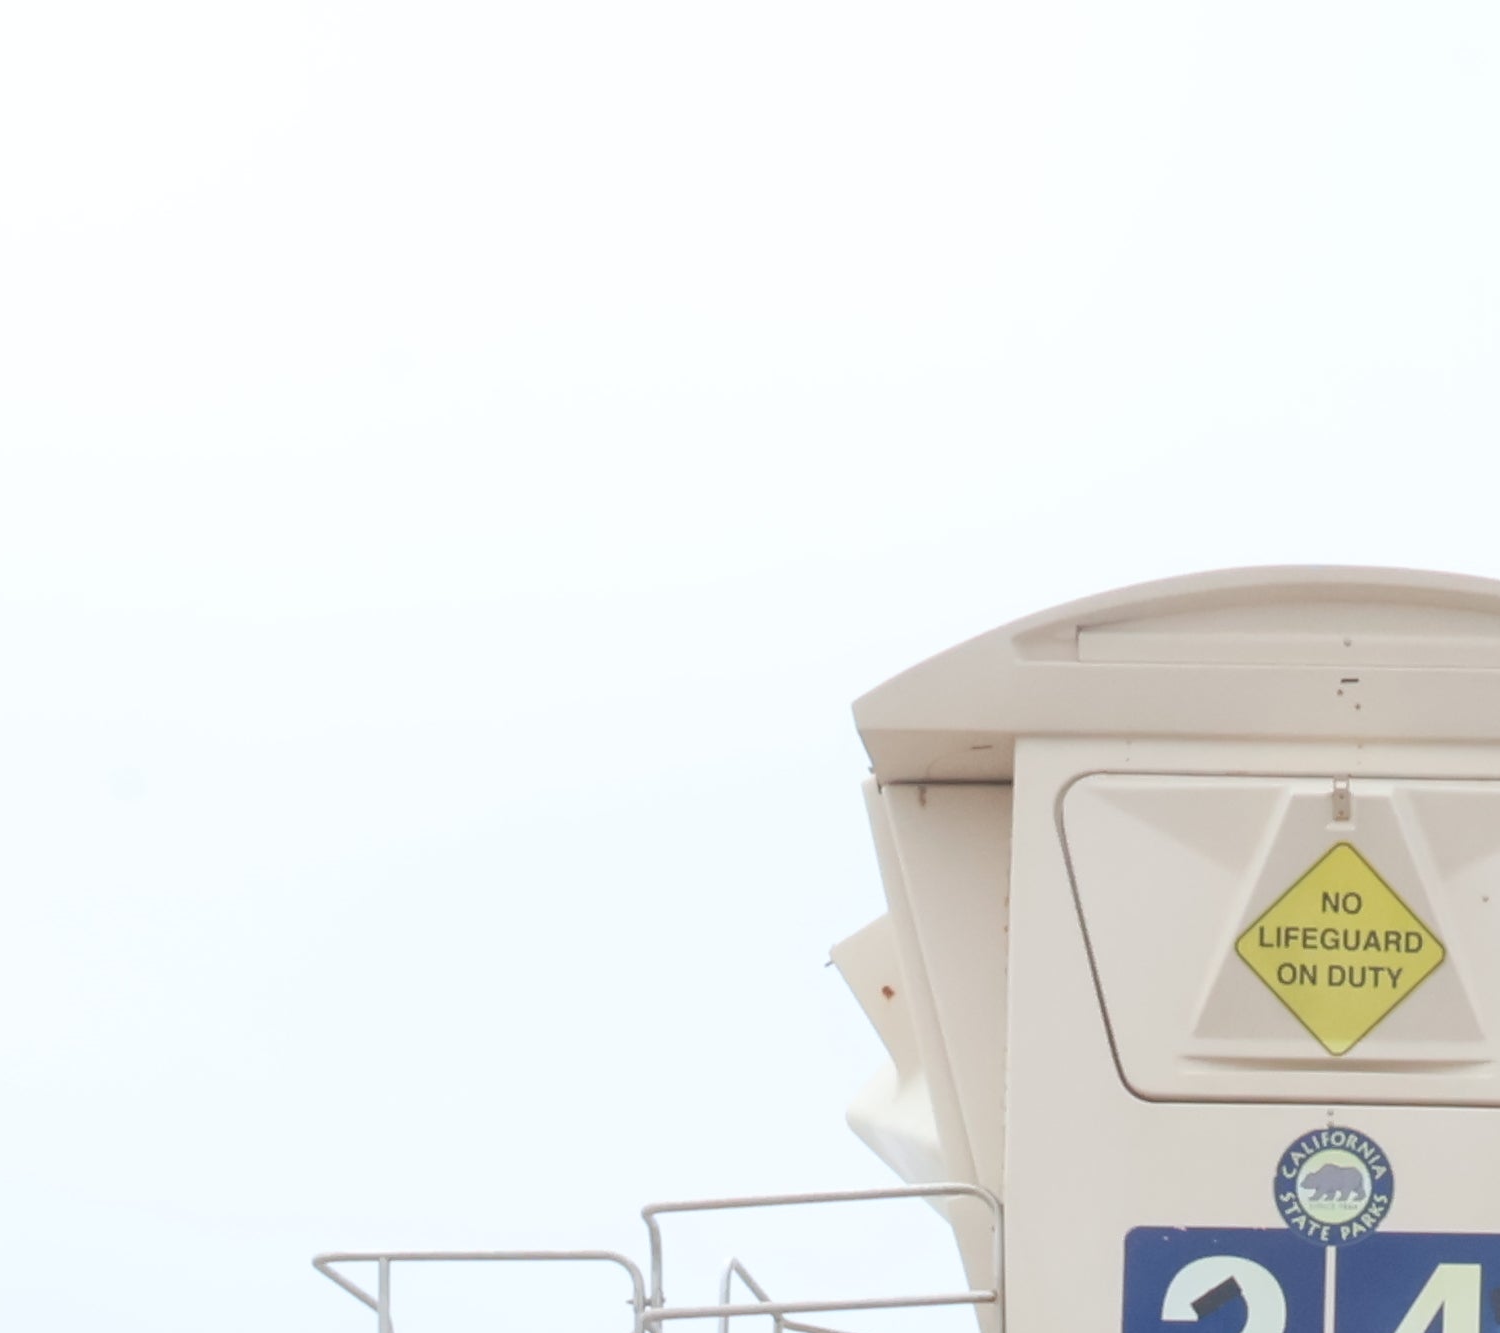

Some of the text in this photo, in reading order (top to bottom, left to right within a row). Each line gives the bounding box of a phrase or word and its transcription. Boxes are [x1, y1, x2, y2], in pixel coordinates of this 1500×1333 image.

[1321, 891, 1363, 914] NO
[1258, 926, 1424, 953] LIFEGUARD
[1276, 962, 1403, 988] ON DUTY
[1282, 1131, 1387, 1180] CALIFORNIA
[1279, 1191, 1388, 1241] STATE PARKS
